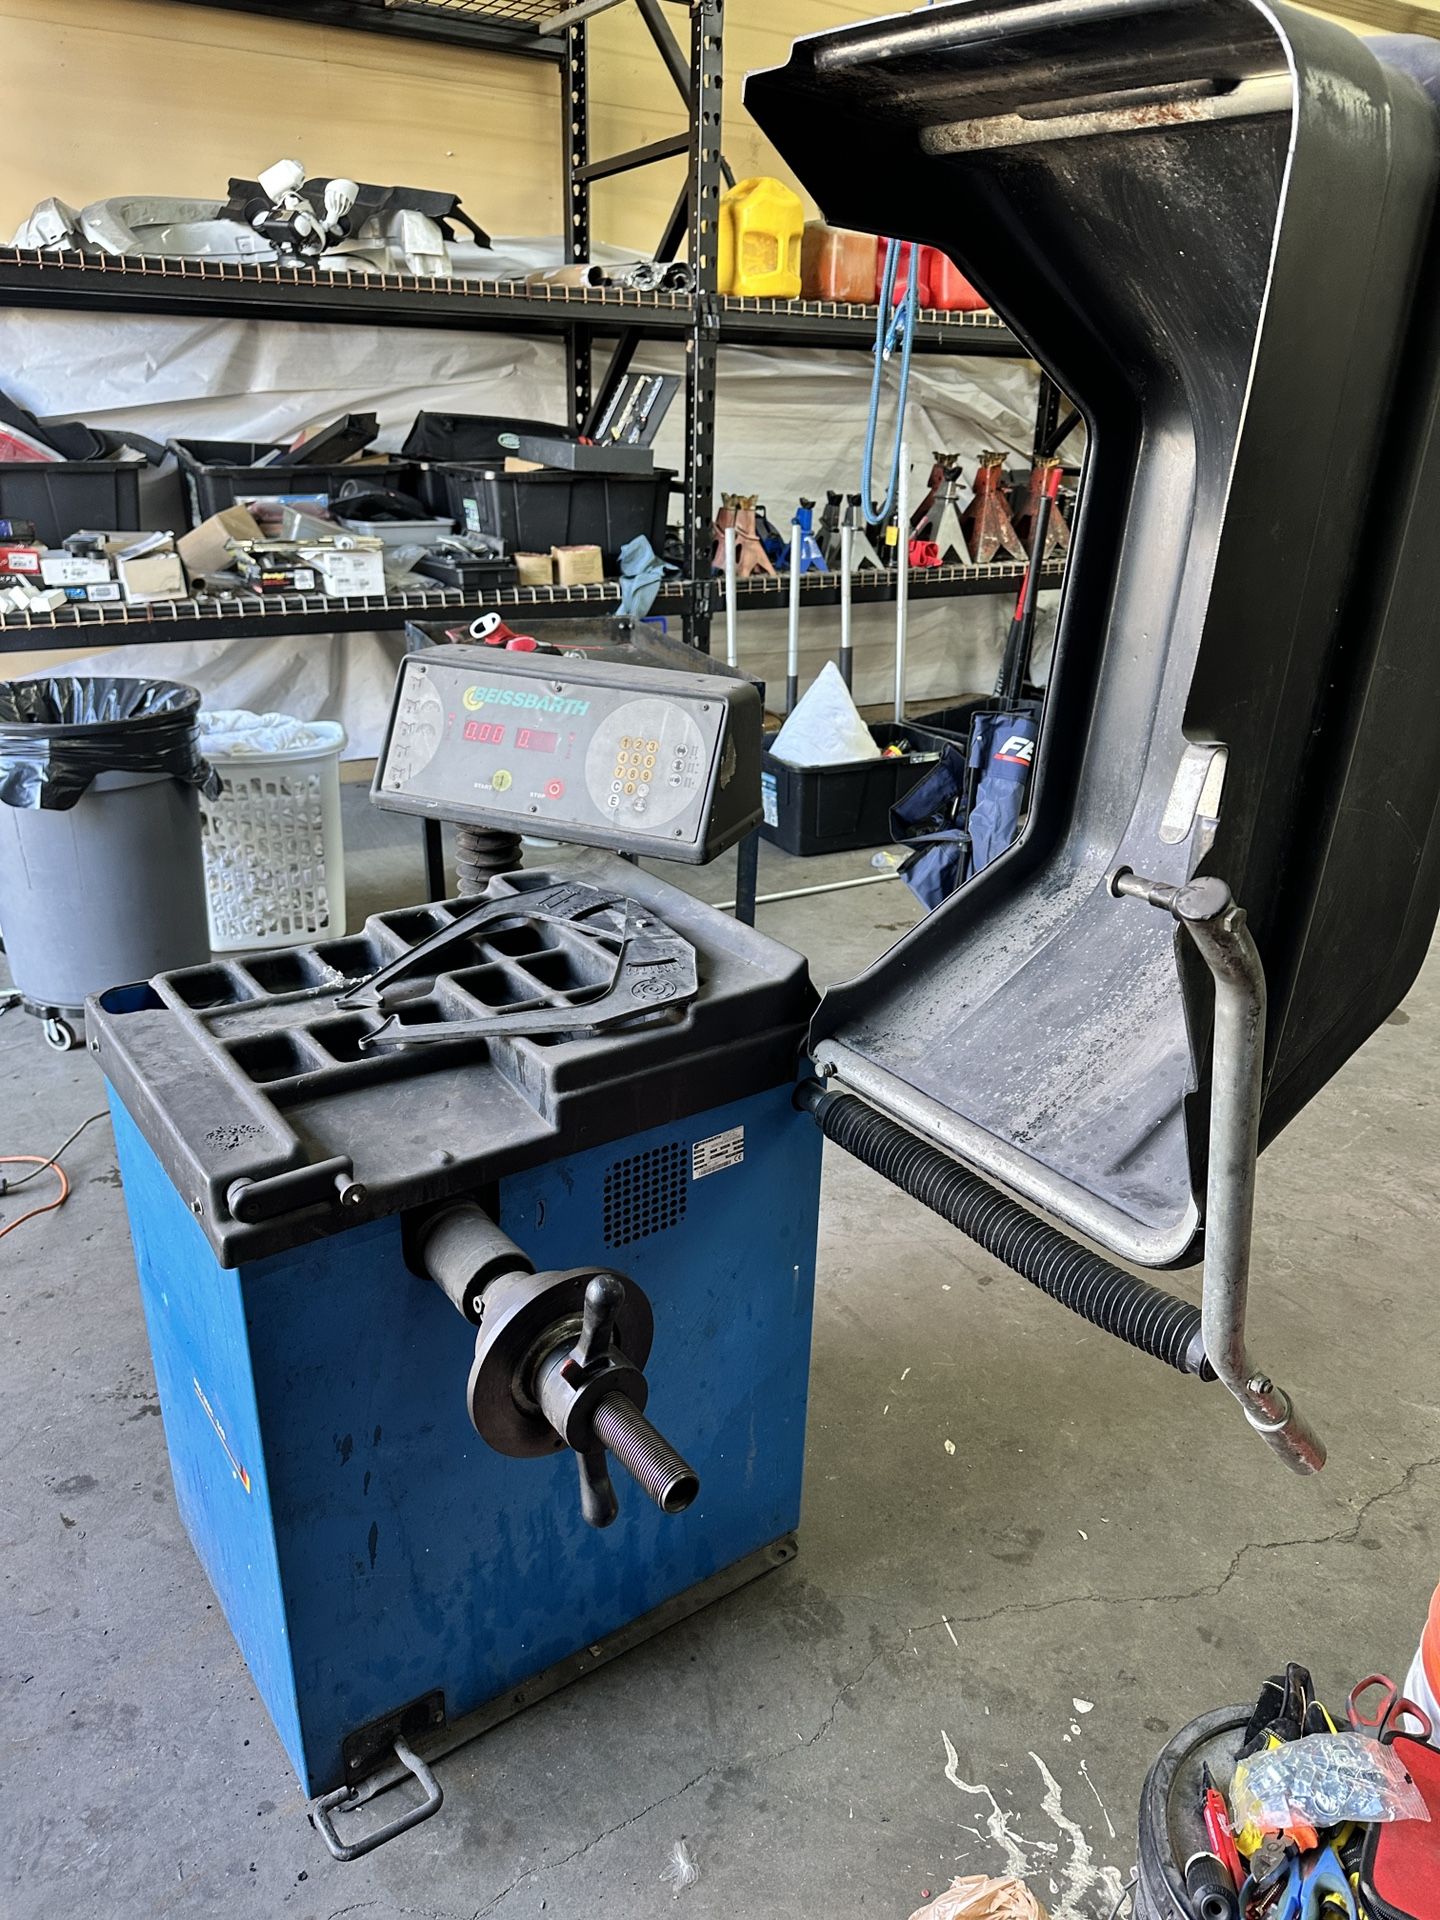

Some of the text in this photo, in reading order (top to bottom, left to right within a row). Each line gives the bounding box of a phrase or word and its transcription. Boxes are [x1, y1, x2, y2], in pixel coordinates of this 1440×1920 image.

[473, 686, 592, 716] BEISSBARTH
[464, 721, 505, 743] 0.00
[635, 740, 643, 750] 2
[648, 742, 656, 751] 3
[619, 753, 653, 766] 4 5 6
[629, 769, 636, 779] 8
[643, 771, 650, 781] 9
[473, 782, 493, 791] START
[613, 781, 634, 794] C 0
[529, 791, 547, 799] STOP
[610, 796, 618, 806] E
